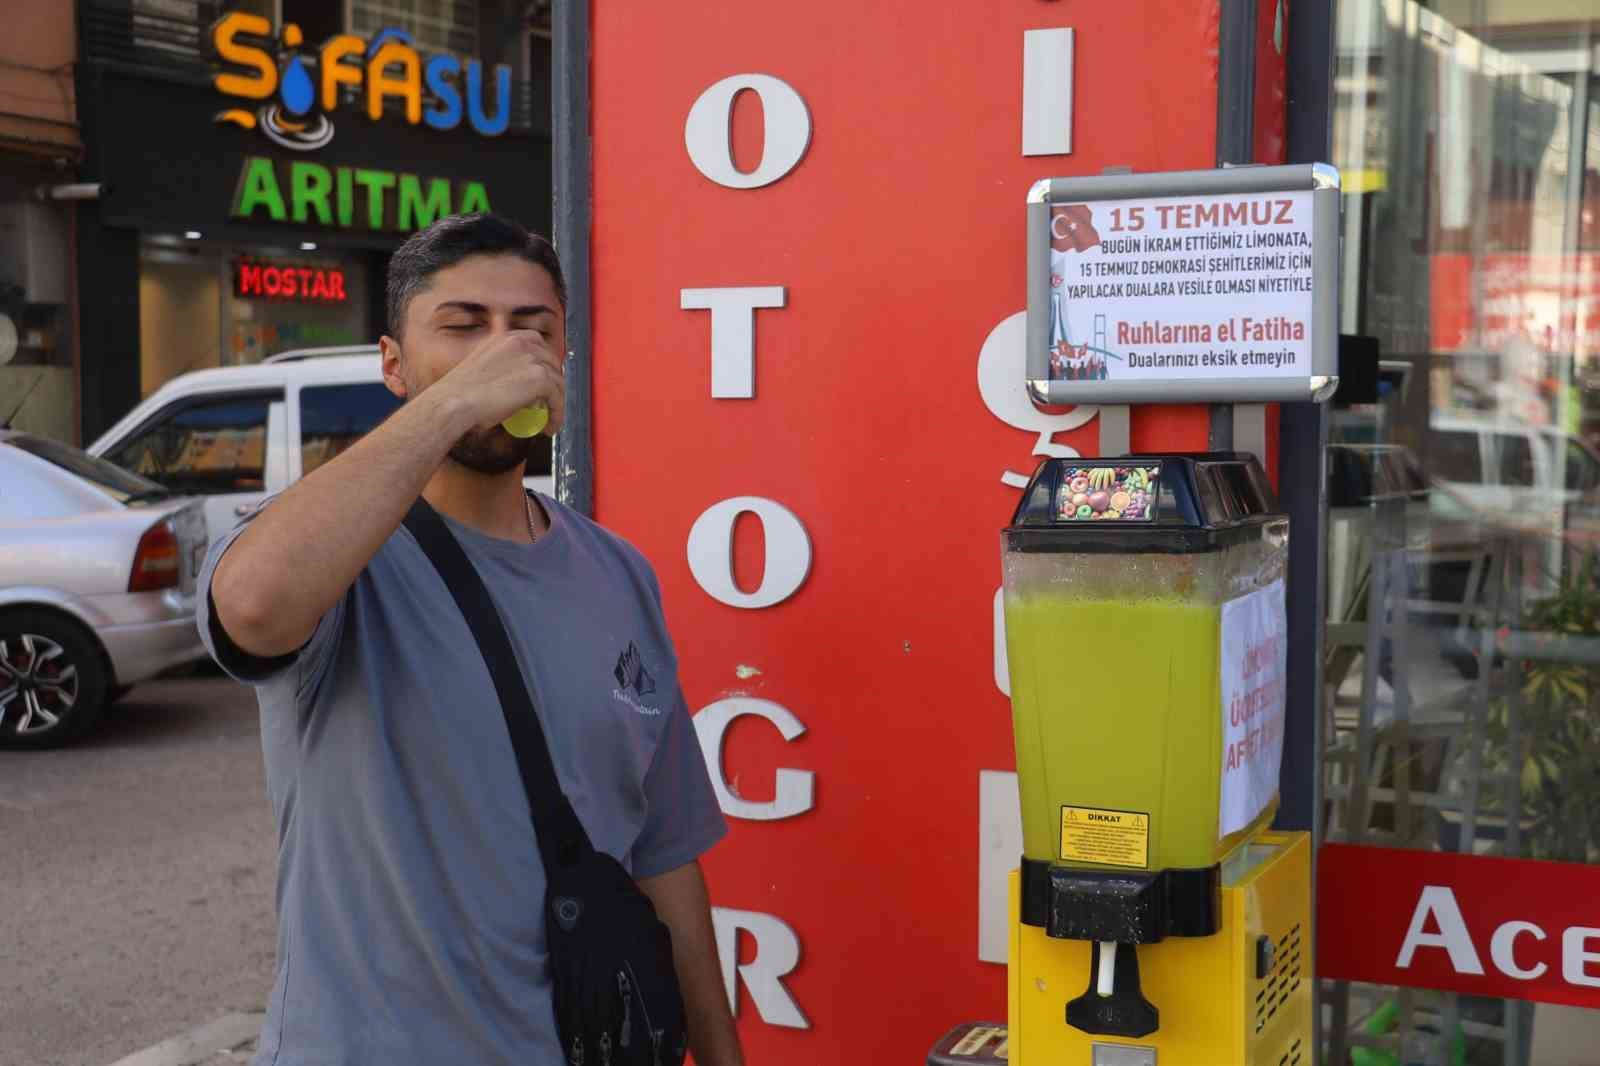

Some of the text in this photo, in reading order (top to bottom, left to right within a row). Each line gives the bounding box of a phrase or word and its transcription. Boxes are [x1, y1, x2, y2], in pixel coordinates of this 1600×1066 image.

[236, 156, 491, 231] ARITMA
[1109, 199, 1294, 232] 15 TEMMUZ
[1101, 230, 1312, 255] BUGÜN İKRAM ETTİĞİMİZ LİMONATA,
[1079, 252, 1312, 277] 15 TEMMUZ DEMOKRASİ ŞEHİTLERİMİZ İÇİN
[240, 264, 346, 300] MOSTAR
[1067, 275, 1312, 300] YAPILACAK DUALARA VESİLE OLMASI NİYETİYLE
[1117, 317, 1305, 345] Ruhlarına el Fatiha
[1128, 348, 1296, 368] Dualarınızı eksik etmeyin
[1087, 811, 1121, 823] DİKKAT
